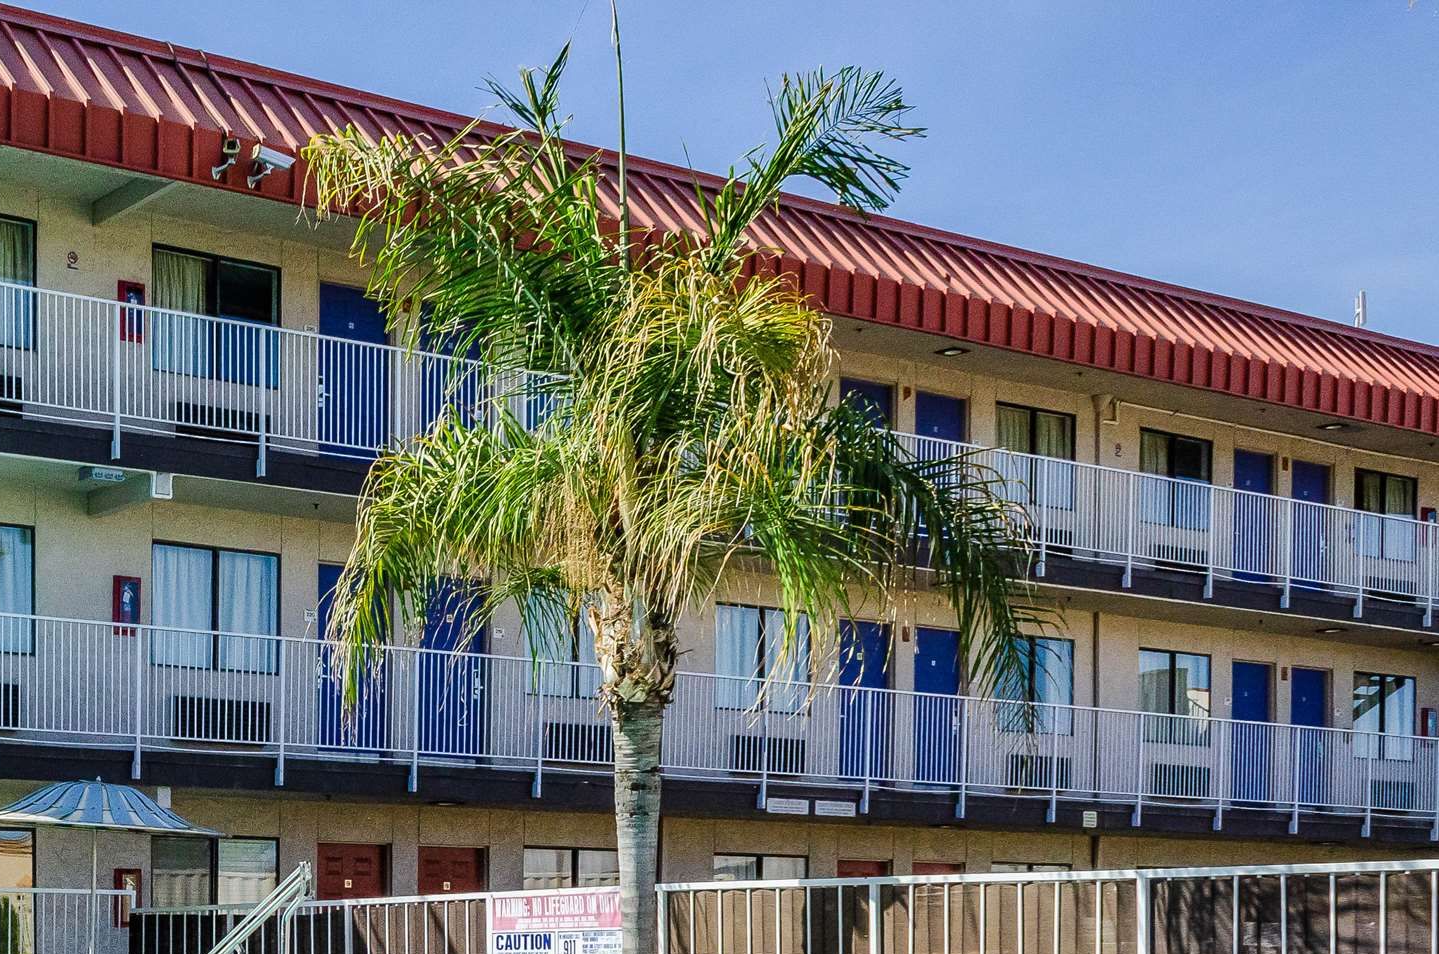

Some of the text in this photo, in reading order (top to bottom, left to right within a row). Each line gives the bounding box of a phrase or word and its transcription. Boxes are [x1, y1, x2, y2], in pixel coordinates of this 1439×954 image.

[495, 893, 620, 918] WARNING: NO LIFEGUARD ON DUTY
[496, 933, 552, 951] CAUTION
